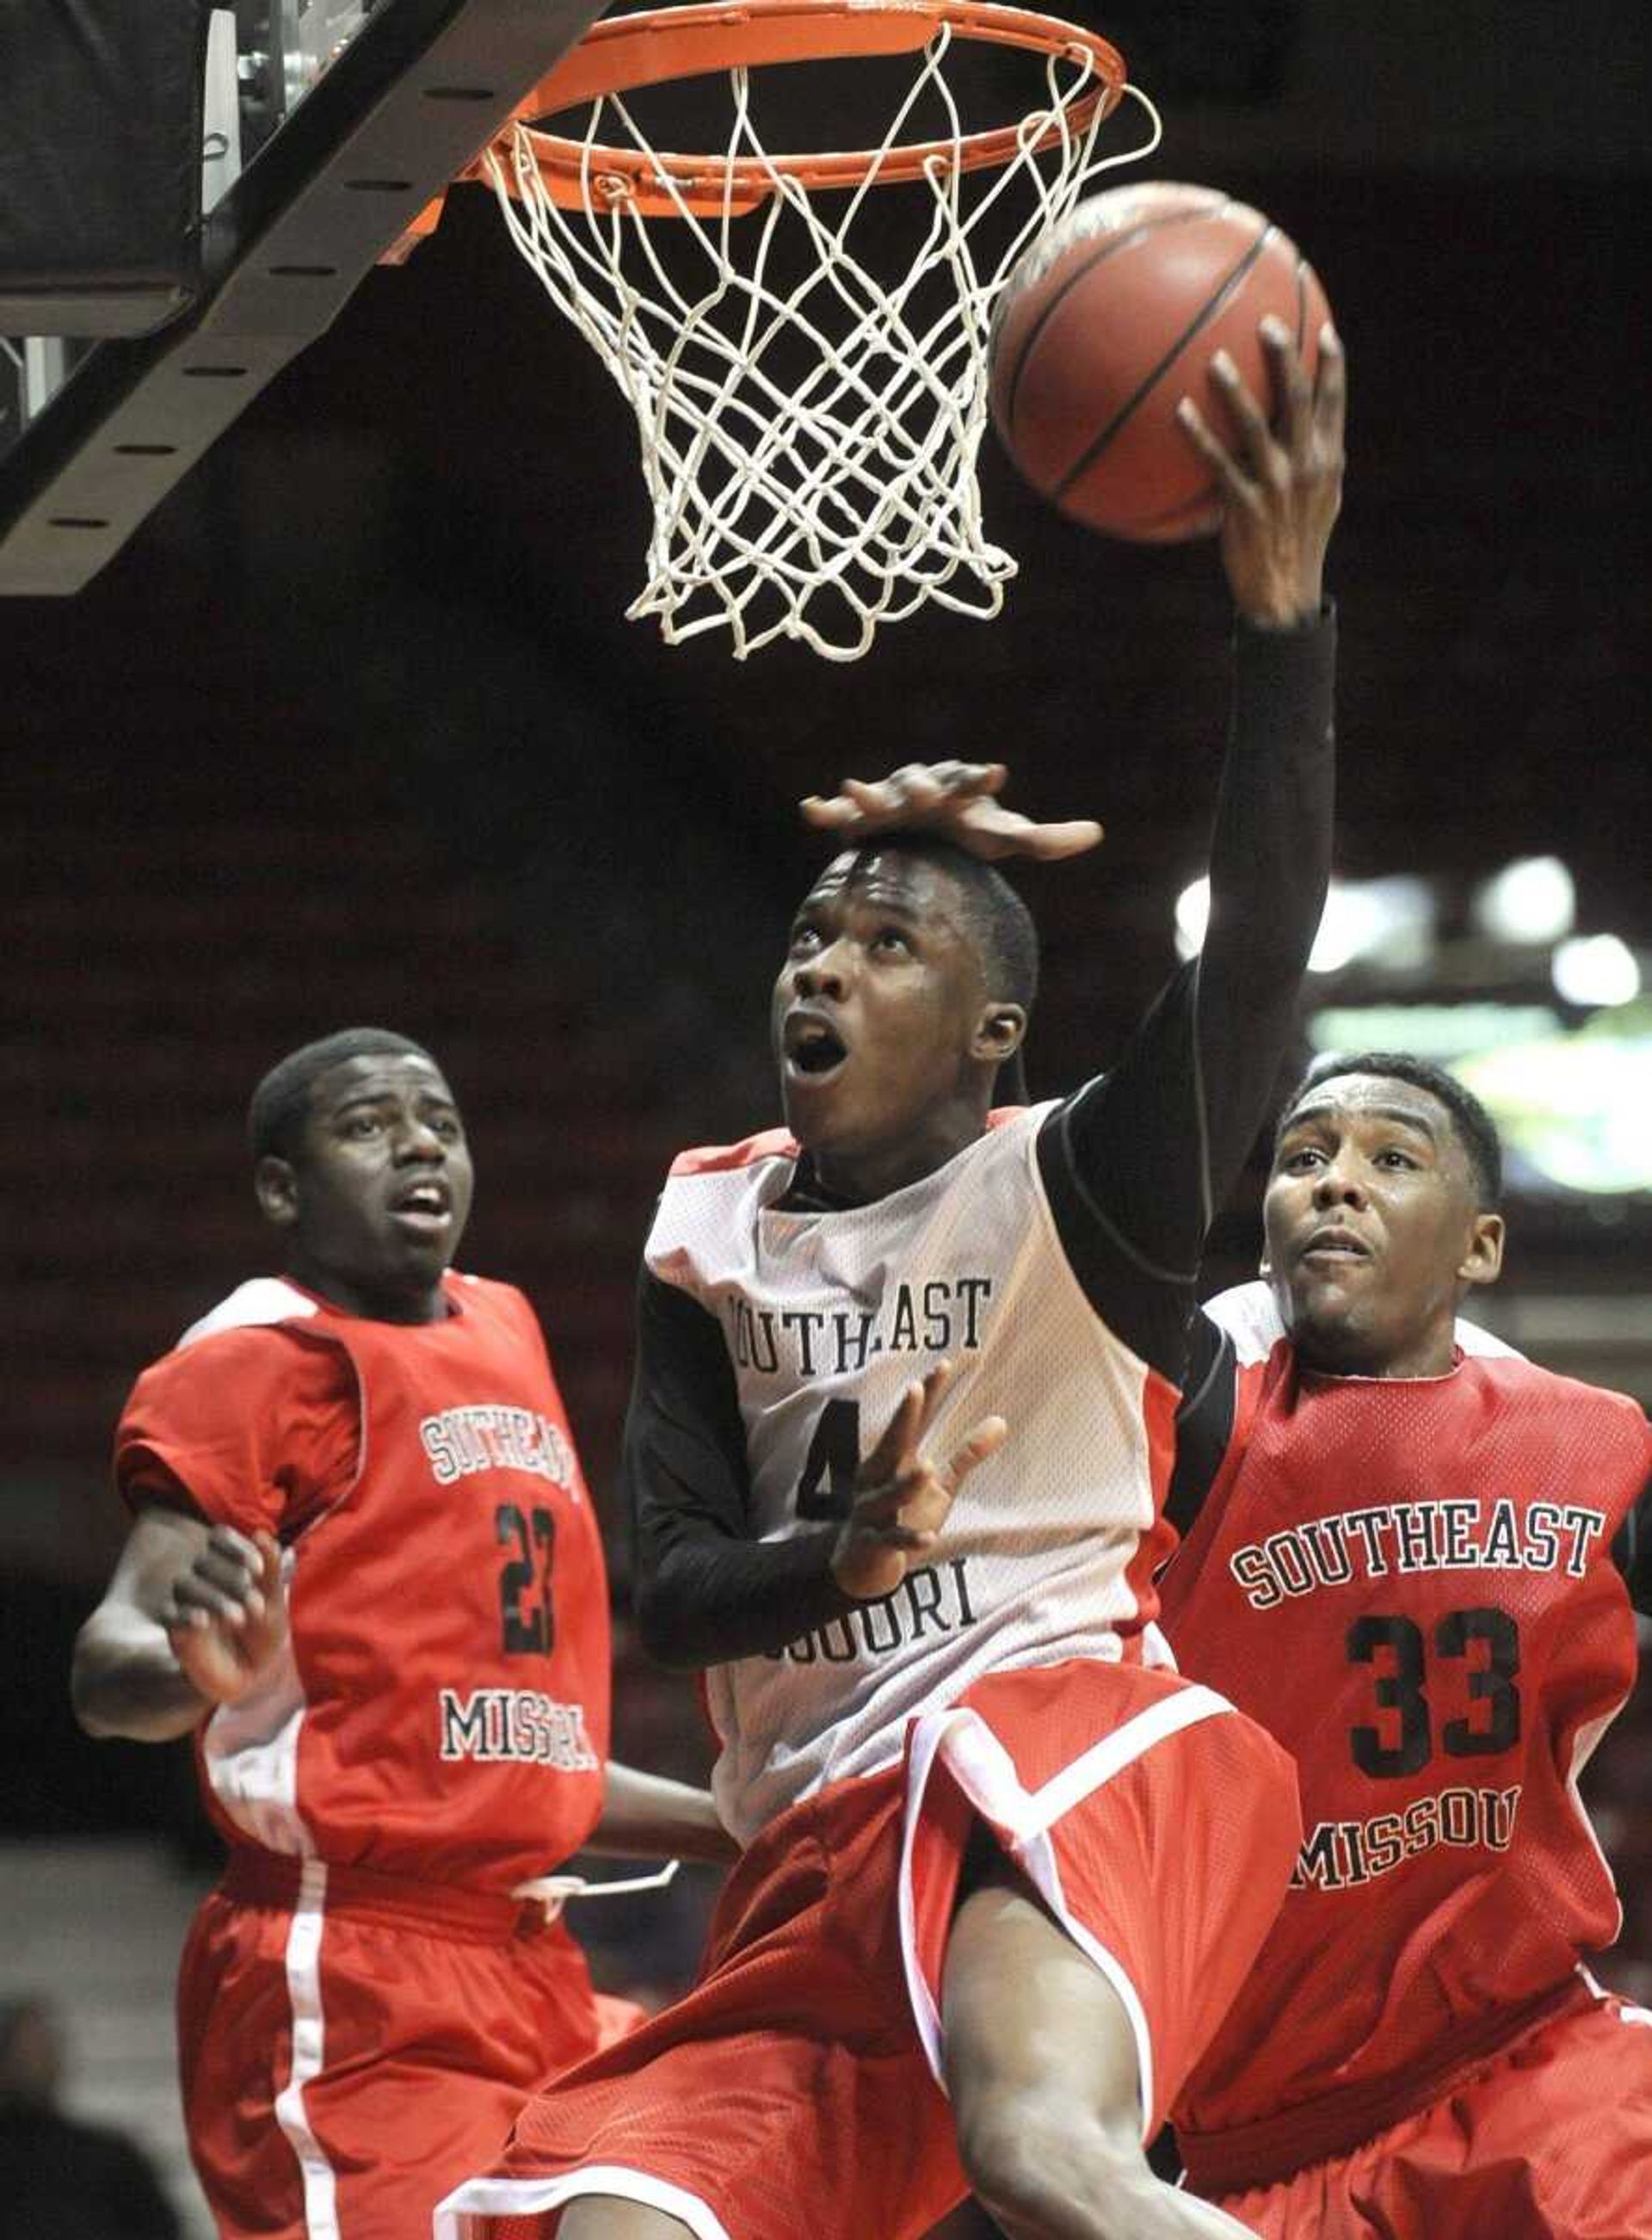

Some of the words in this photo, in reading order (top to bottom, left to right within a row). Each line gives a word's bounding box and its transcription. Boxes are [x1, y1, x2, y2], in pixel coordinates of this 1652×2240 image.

[796, 1399, 864, 1521] 4
[1230, 1498, 1606, 1611] SOUTHEAST
[1346, 1607, 1522, 1780] 33
